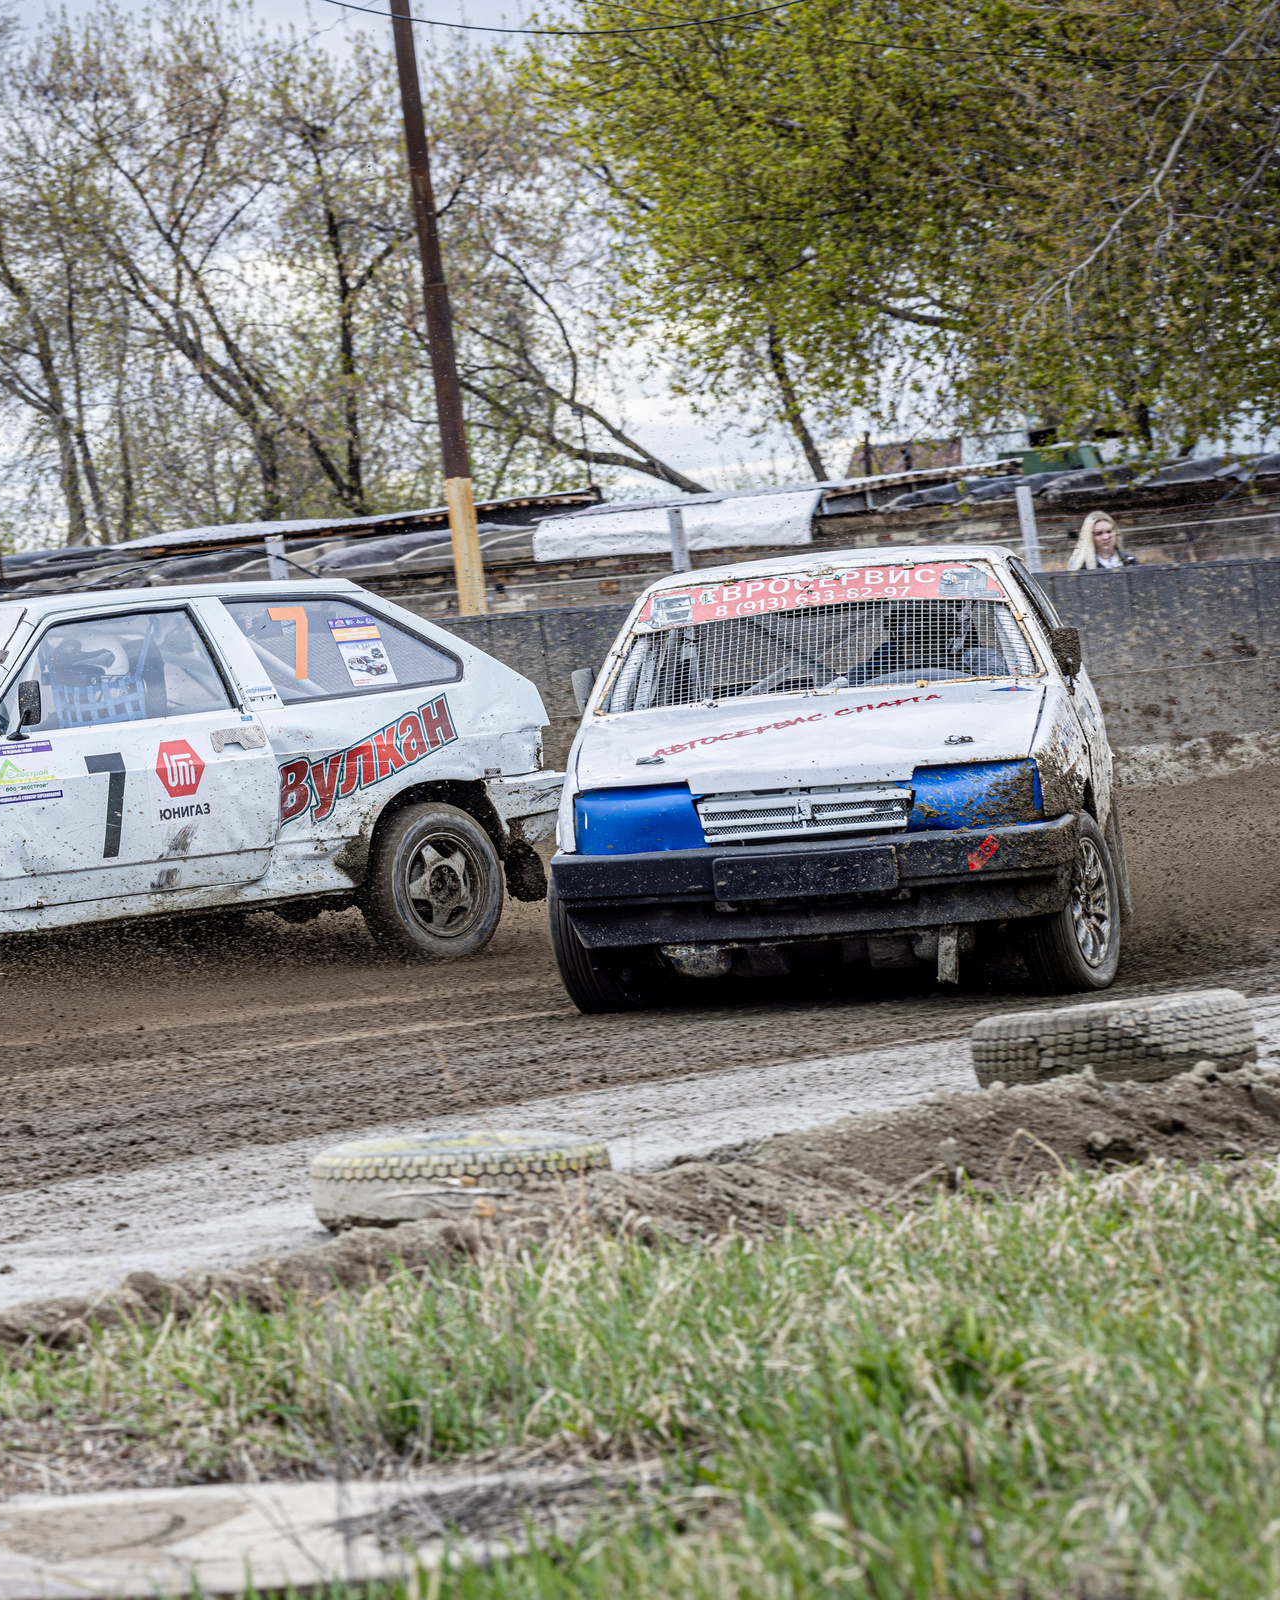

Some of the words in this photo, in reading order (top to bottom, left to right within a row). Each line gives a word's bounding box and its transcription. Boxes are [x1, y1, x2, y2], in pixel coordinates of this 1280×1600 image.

[714, 605, 729, 617] 8
[735, 596, 787, 616] (913)
[794, 585, 912, 604] 633-82-97
[267, 607, 309, 680] 7
[278, 692, 459, 828] Вулкан
[83, 752, 126, 858] 7
[159, 803, 211, 821] ЮНИГАЗ
